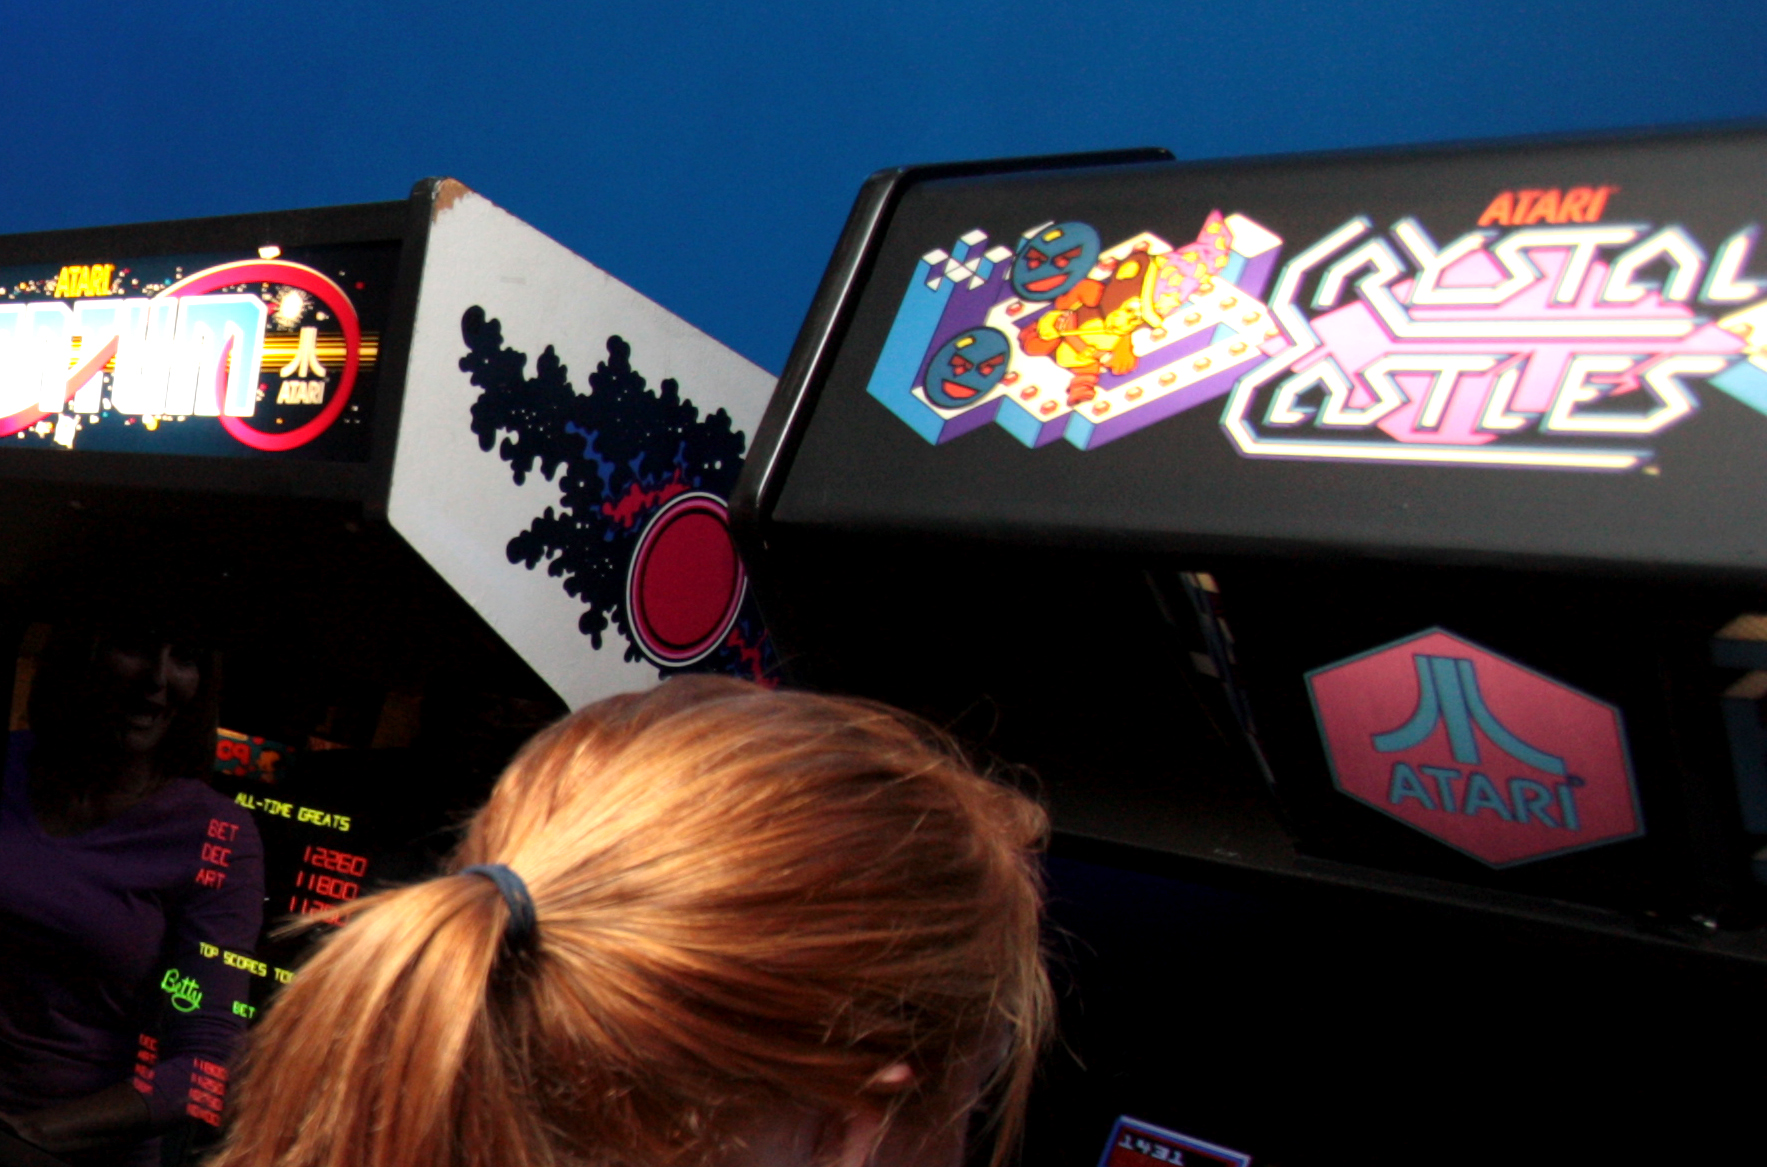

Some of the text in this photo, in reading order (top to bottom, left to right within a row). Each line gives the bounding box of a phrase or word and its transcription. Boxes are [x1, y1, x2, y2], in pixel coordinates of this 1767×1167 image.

[1477, 186, 1608, 226] ATARI
[54, 264, 115, 299] ATARI
[1266, 214, 1767, 342] CRYSTAL
[276, 381, 325, 405] ATARI
[1219, 342, 1737, 471] CASTLES
[234, 792, 351, 831] ALL-TIME GREATS
[1387, 761, 1582, 832] ATARI
[207, 818, 368, 877] BET 12260
[195, 868, 226, 889] ART
[200, 842, 359, 900] DEC 11800
[199, 941, 219, 958] TOP
[224, 951, 268, 978] SCORES
[160, 968, 203, 1013] Betty
[232, 1000, 256, 1019] BET
[1117, 1133, 1185, 1167] 1431
